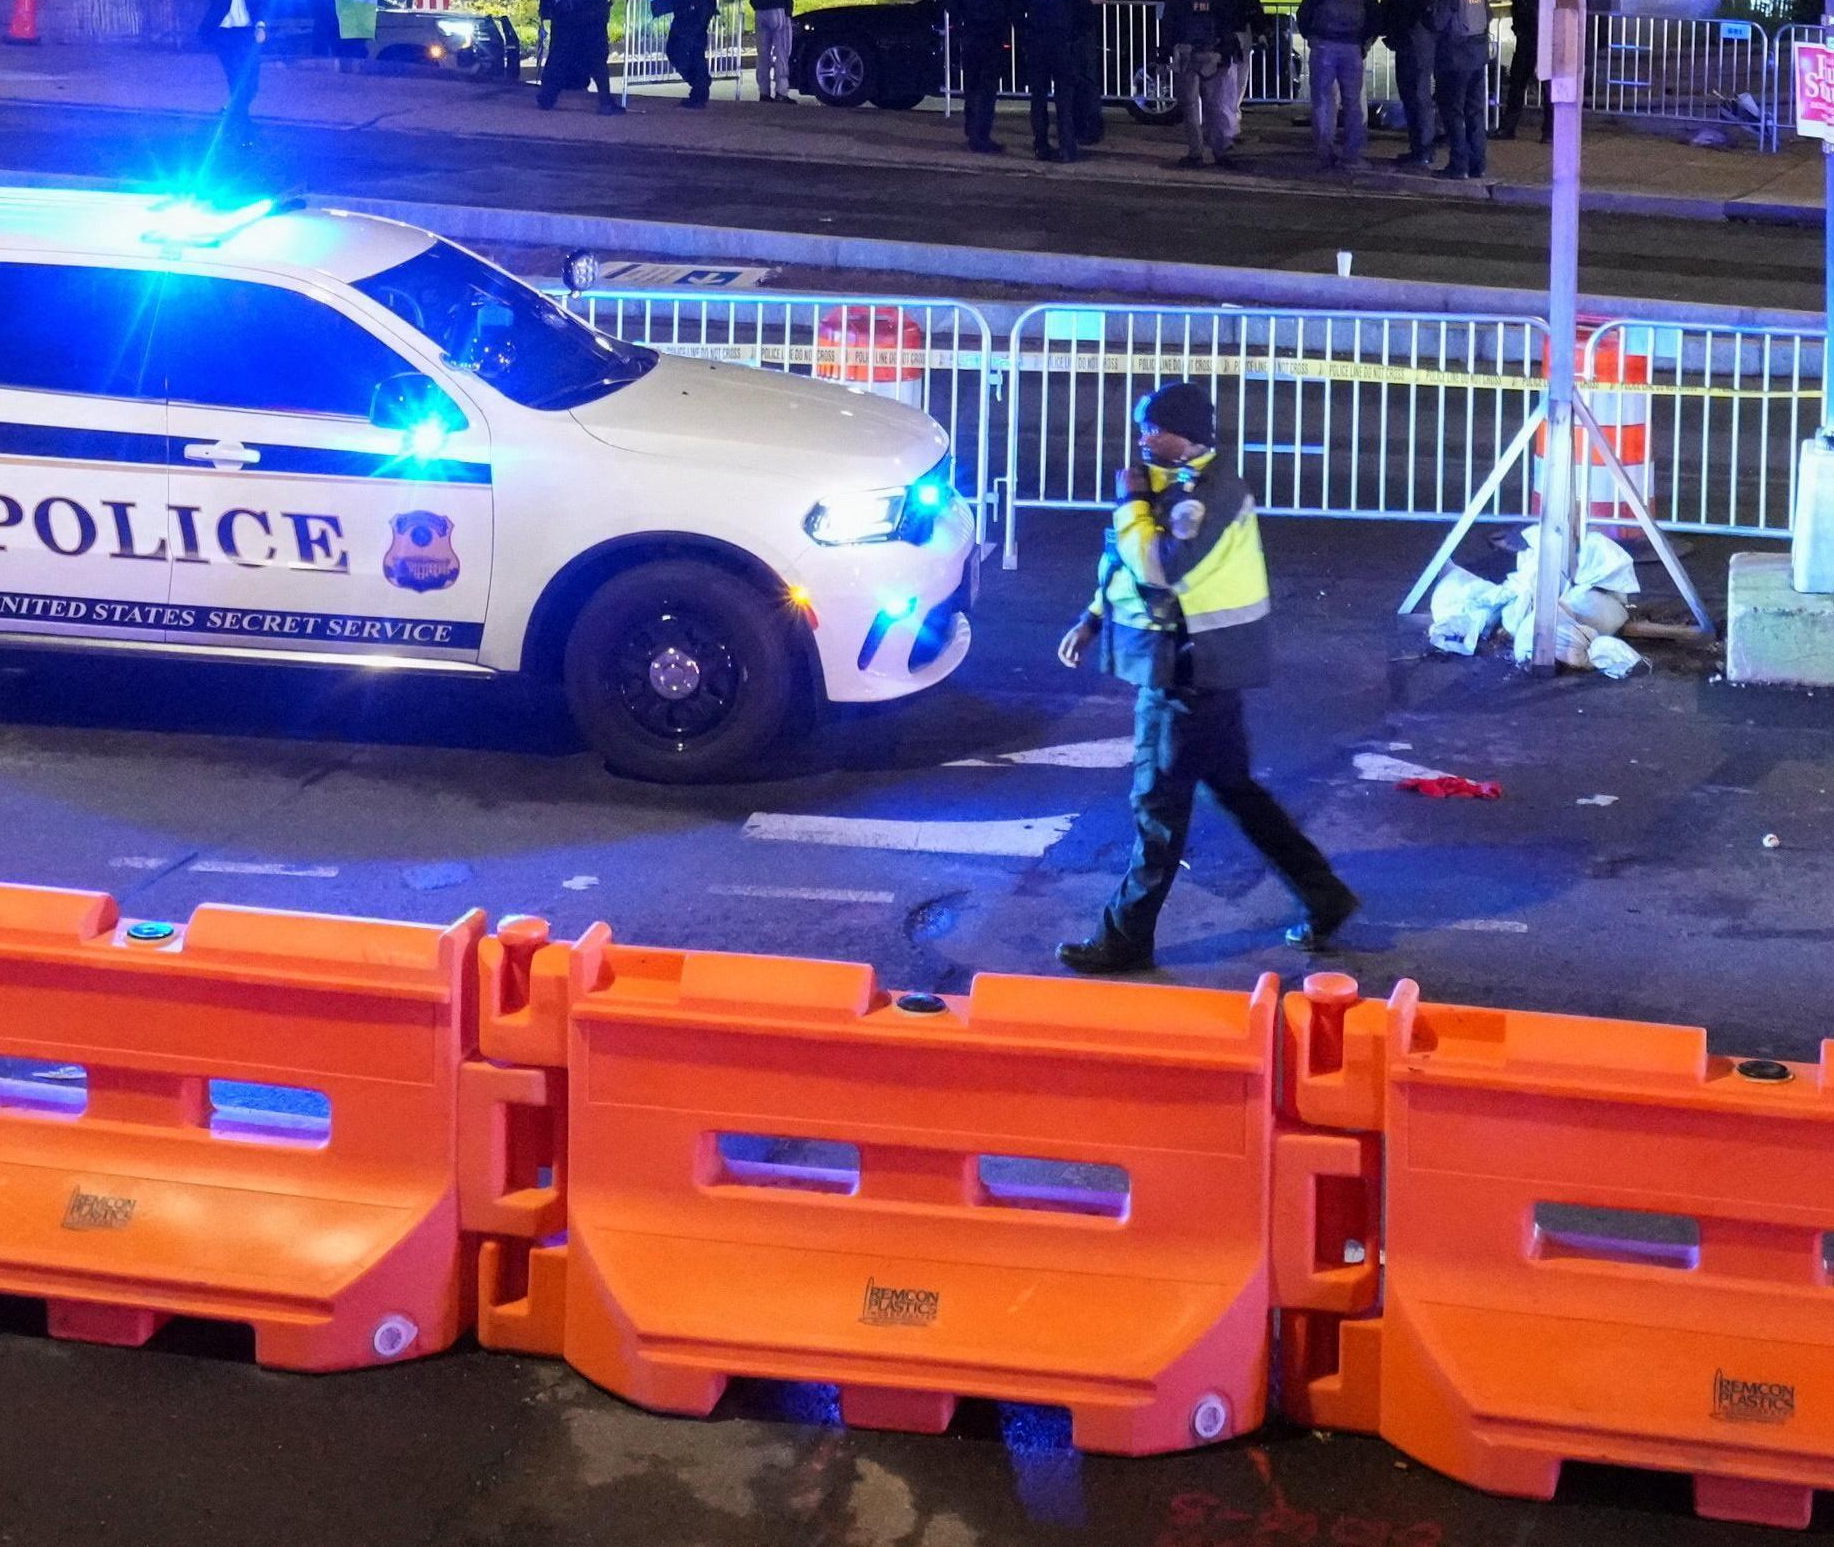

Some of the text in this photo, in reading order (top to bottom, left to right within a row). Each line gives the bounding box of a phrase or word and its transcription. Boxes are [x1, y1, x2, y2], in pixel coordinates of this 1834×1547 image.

[93, 603, 196, 628] STATES
[206, 611, 322, 635] SECRET
[326, 619, 453, 644] SERVICE
[870, 1286, 940, 1303] REMCON
[1718, 1379, 1795, 1399] REMCON
